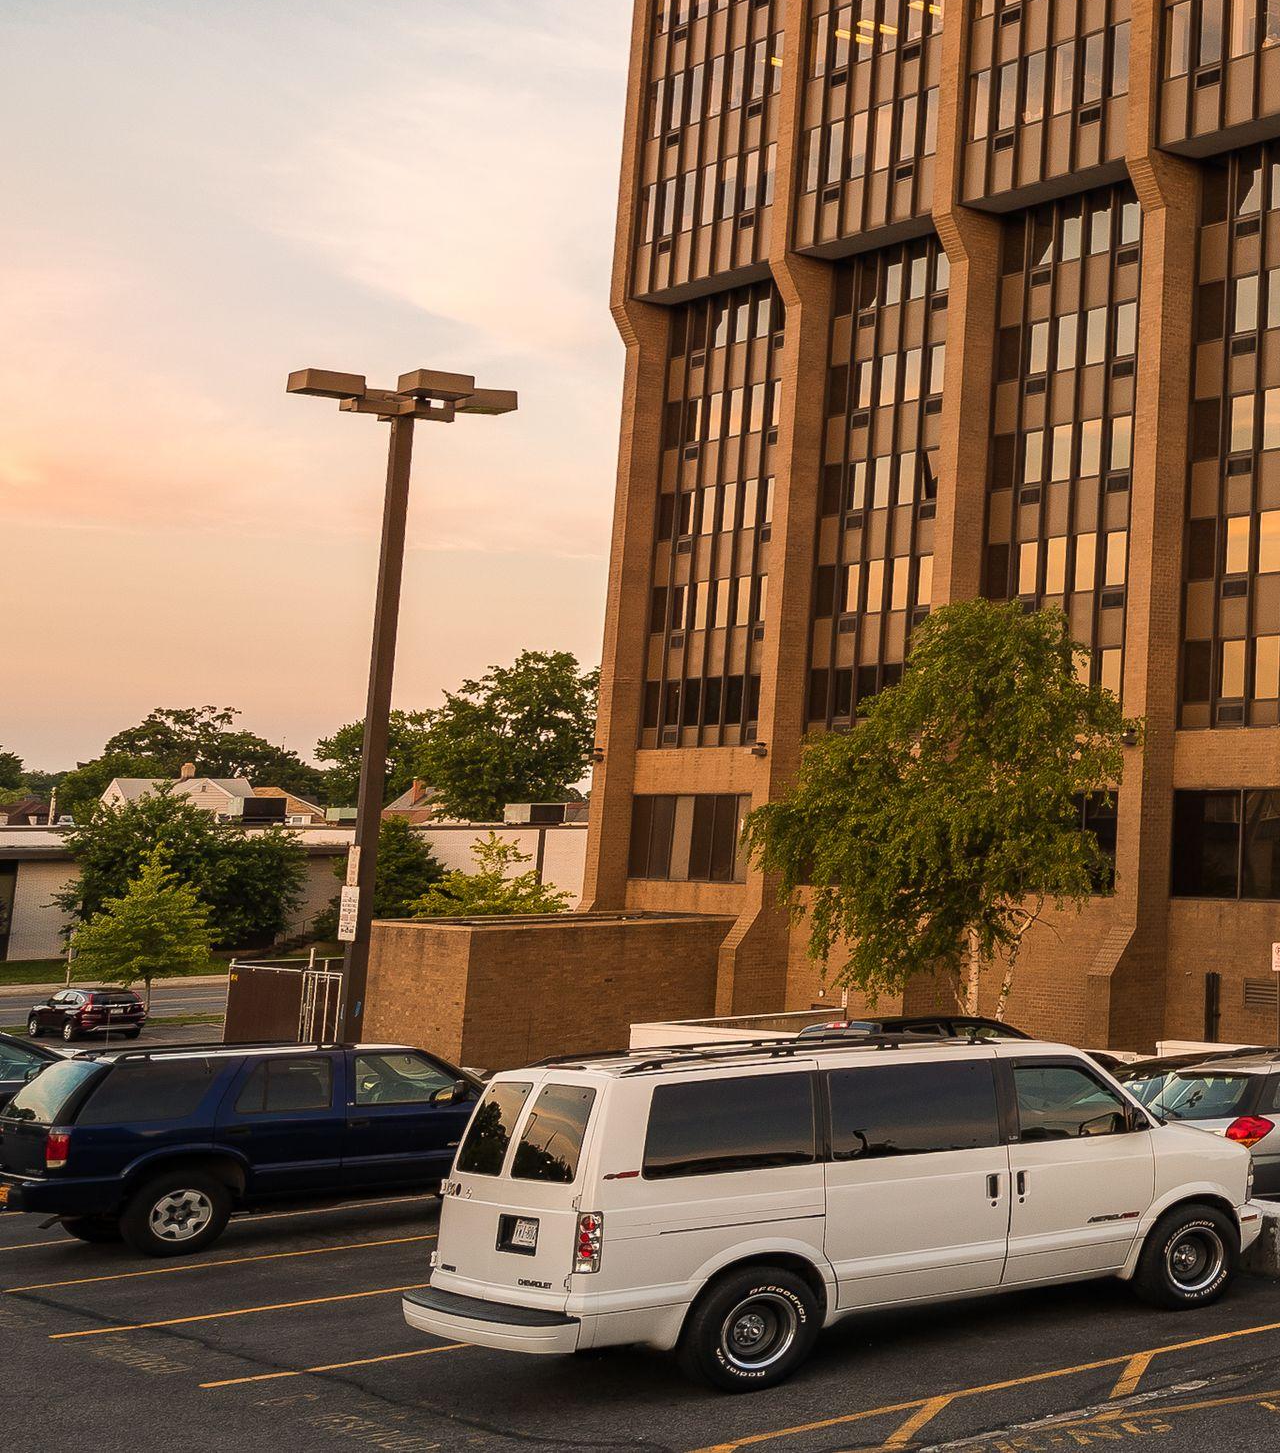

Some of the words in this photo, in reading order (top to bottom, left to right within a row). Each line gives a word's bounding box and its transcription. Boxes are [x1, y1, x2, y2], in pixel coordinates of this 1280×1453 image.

[517, 1278, 553, 1290] CHEVROLET
[749, 1285, 807, 1323] BFGoodrich
[726, 1365, 766, 1377] Radial
